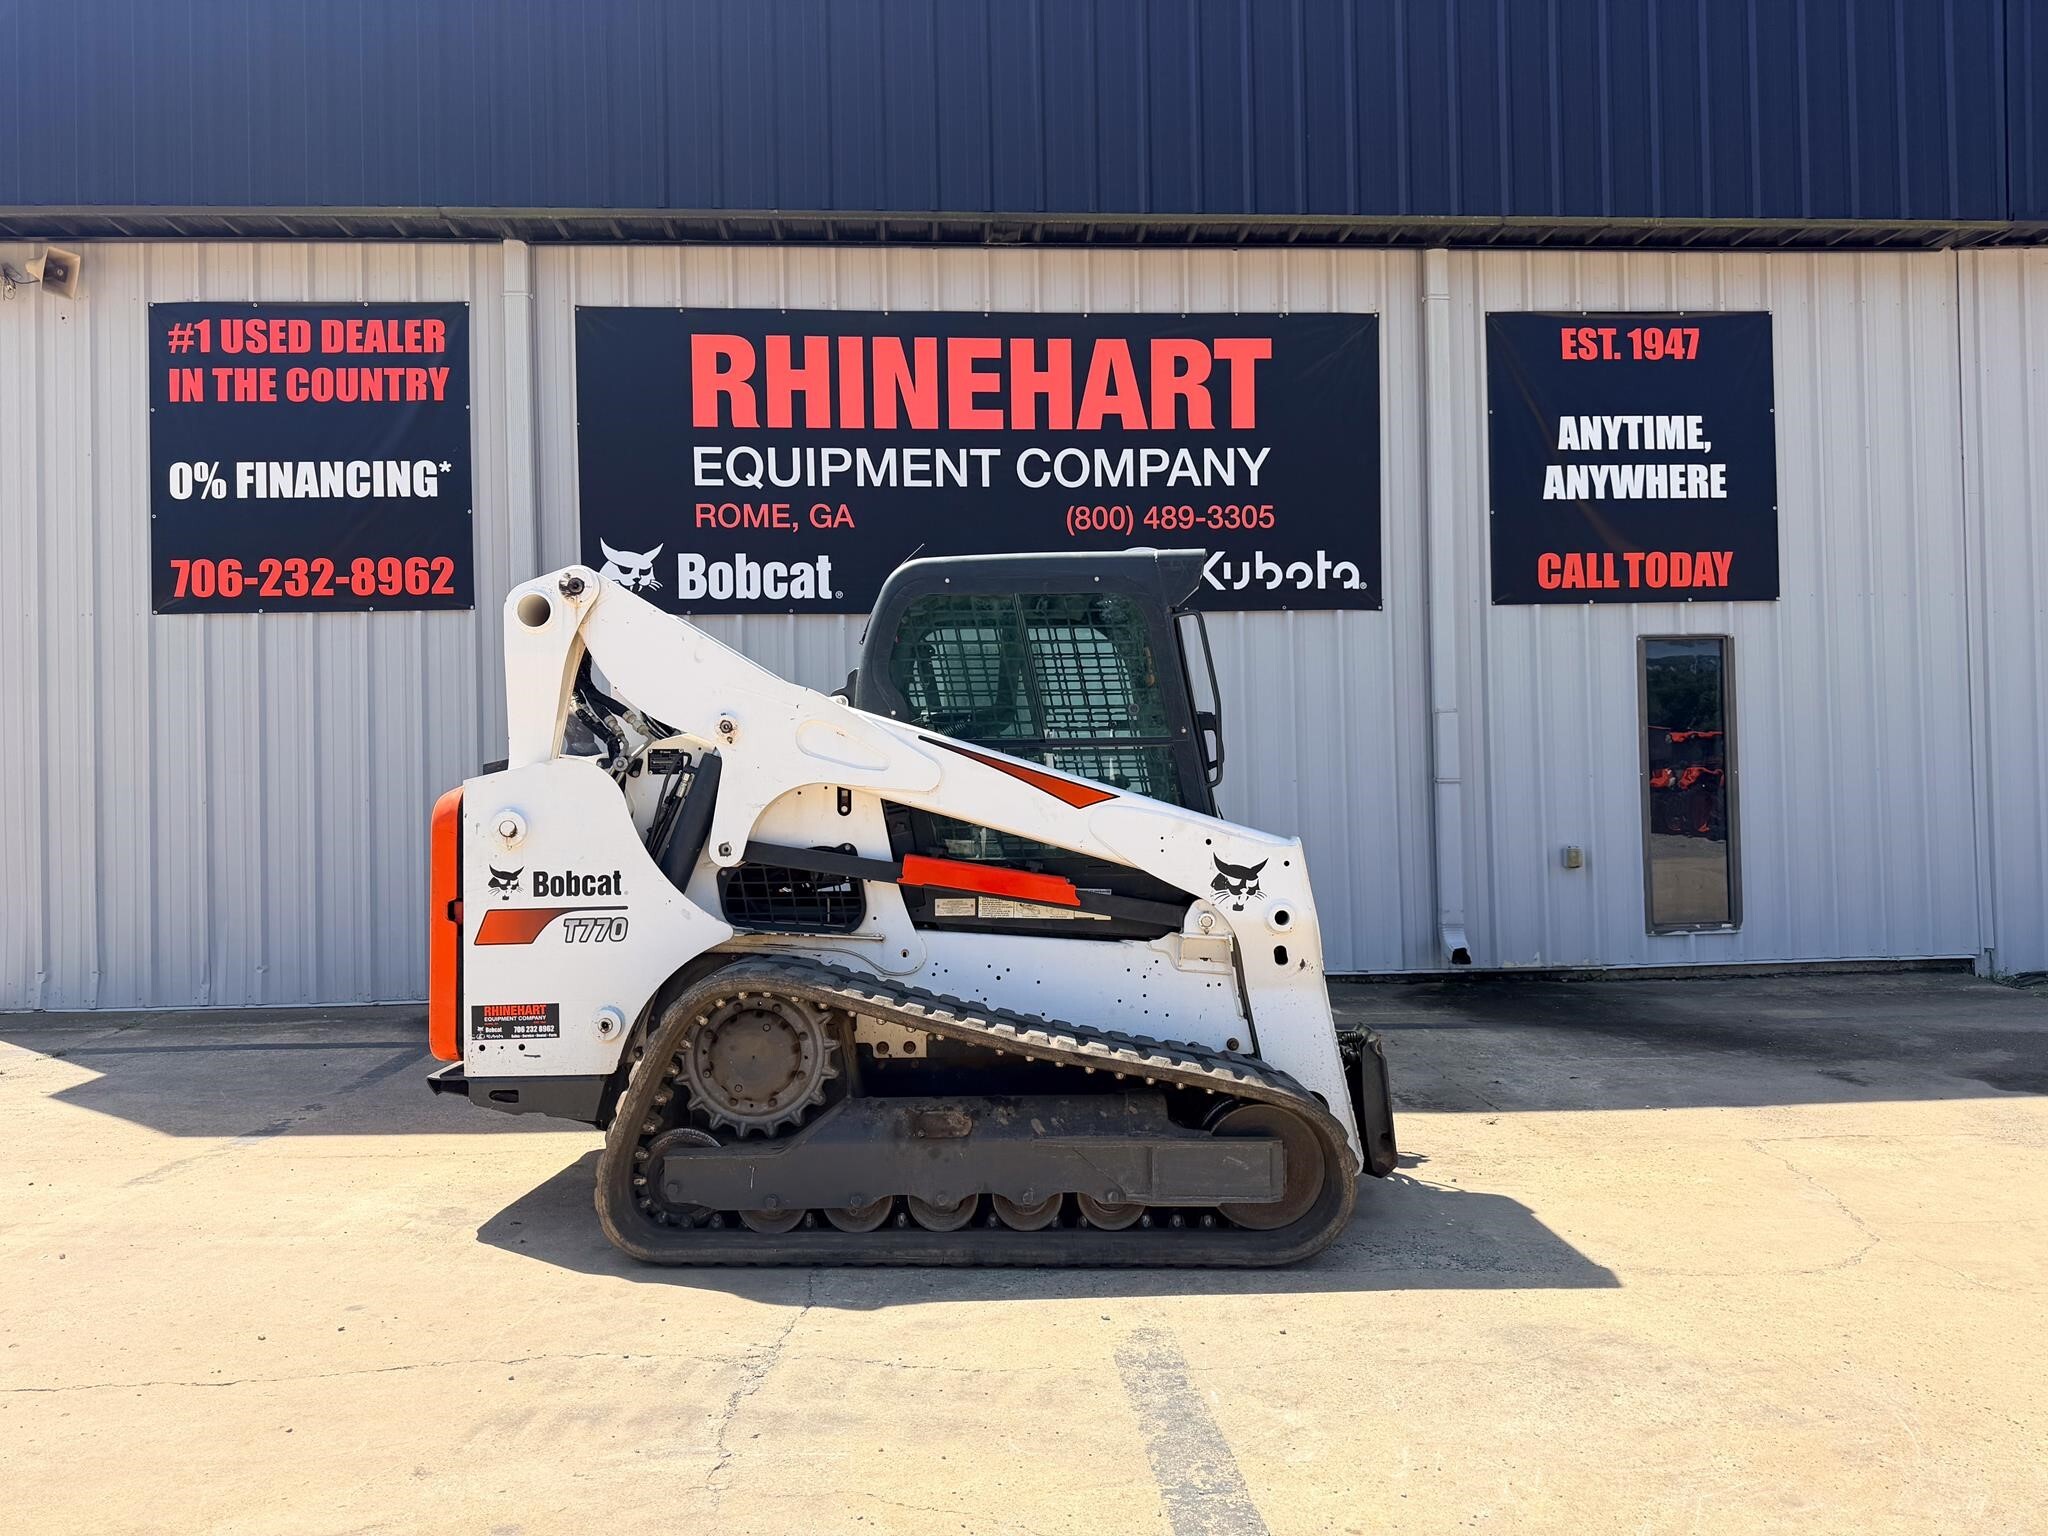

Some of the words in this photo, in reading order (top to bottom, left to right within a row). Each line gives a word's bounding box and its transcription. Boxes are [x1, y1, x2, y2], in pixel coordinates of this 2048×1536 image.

[168, 319, 211, 354] #1
[220, 319, 311, 353] USED
[321, 319, 446, 353] DEALER
[1561, 327, 1621, 360] EST.
[1627, 327, 1700, 360] 1947
[168, 368, 204, 402] IN
[212, 367, 277, 402] THE
[286, 367, 450, 402] COUNTRY
[690, 333, 1273, 431] RHINEHART
[1557, 415, 1712, 453] ANYTIME,
[169, 461, 227, 500] 0%
[693, 446, 1001, 490] EQUIPMENT
[1016, 447, 1271, 489] COMPANY
[1542, 463, 1728, 500] ANYWHERE
[695, 503, 799, 533] ROME,
[809, 503, 855, 529] GA
[1065, 505, 1135, 536] (800)
[1143, 505, 1275, 531] 489-3305
[170, 556, 455, 597] 706-232-8962
[677, 553, 833, 600] Bobcat
[1537, 552, 1620, 590] CALL
[1623, 551, 1734, 588] TODAY
[532, 870, 623, 898] Bobcat
[563, 916, 629, 944] T770
[484, 1005, 546, 1016] RHINEHART
[526, 1025, 537, 1033] 232
